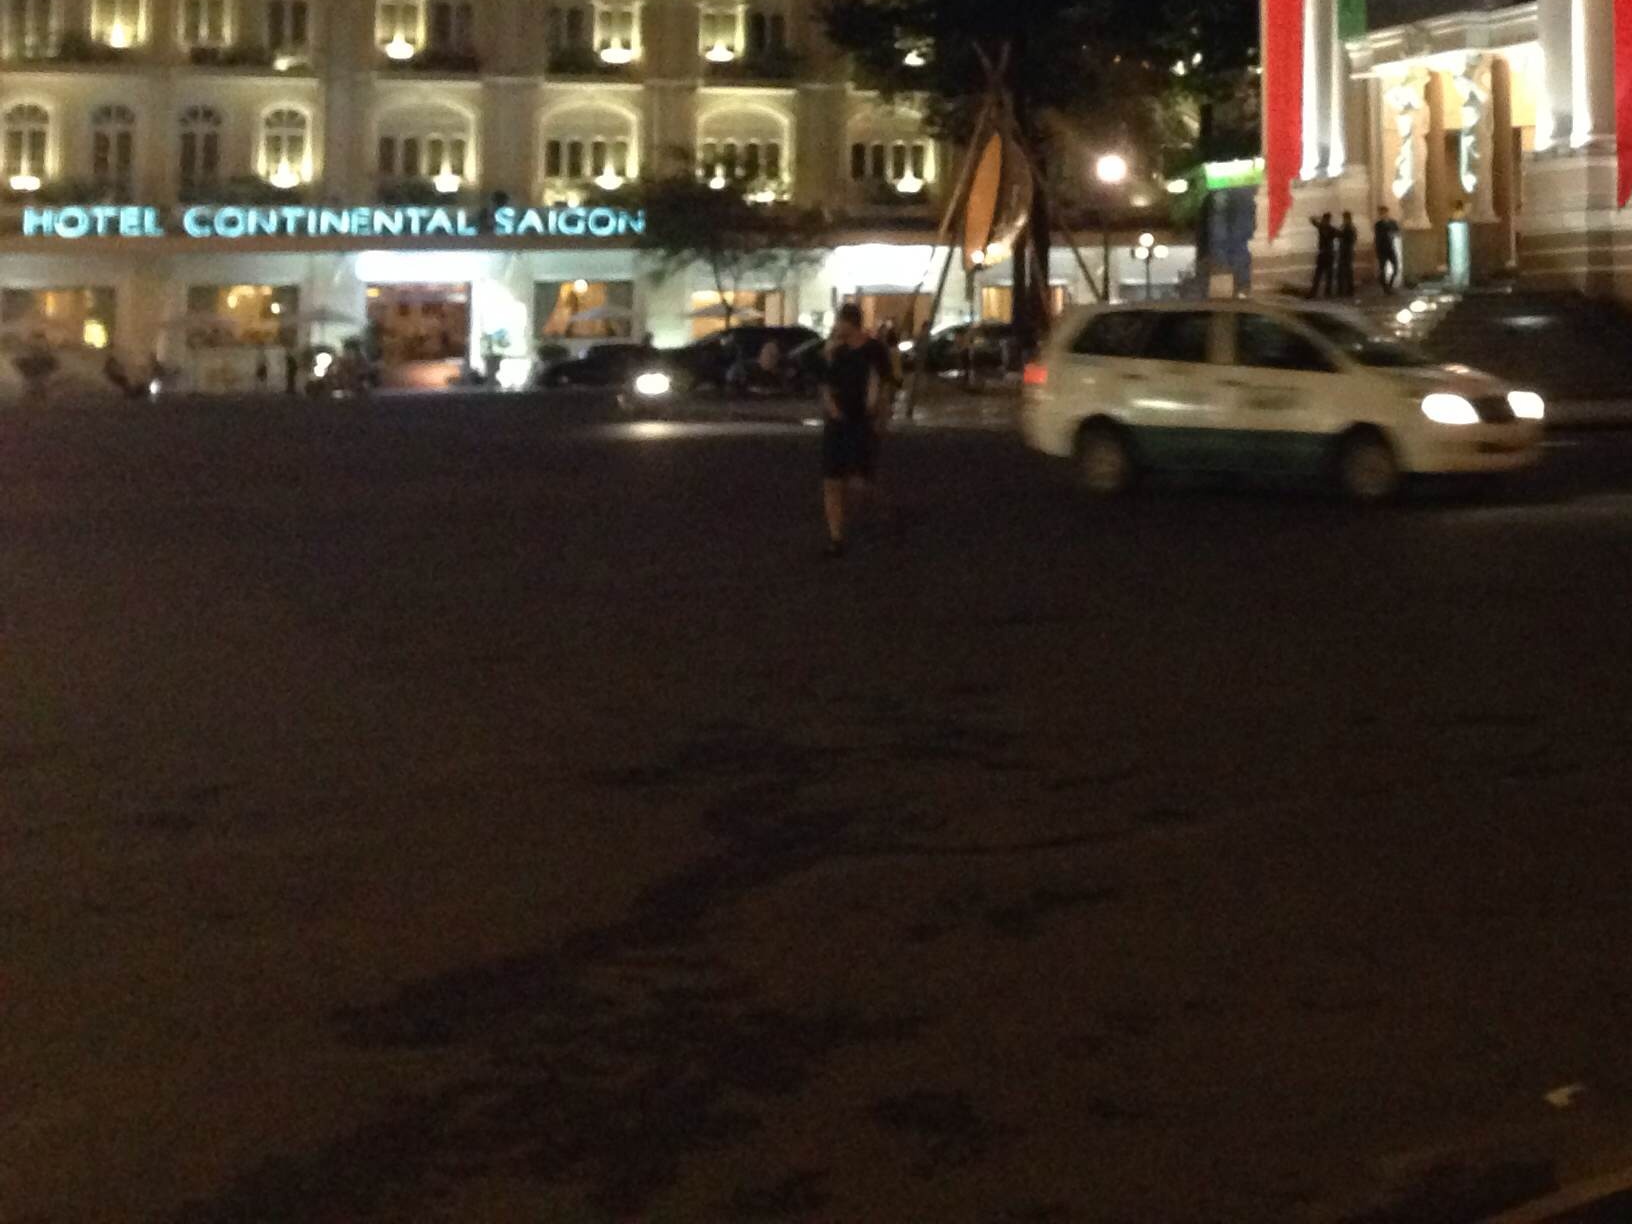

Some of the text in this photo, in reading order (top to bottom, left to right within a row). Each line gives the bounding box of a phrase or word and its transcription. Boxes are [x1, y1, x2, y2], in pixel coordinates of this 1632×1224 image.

[23, 206, 646, 237] HOTEL CONTINENTAL SAIGON
